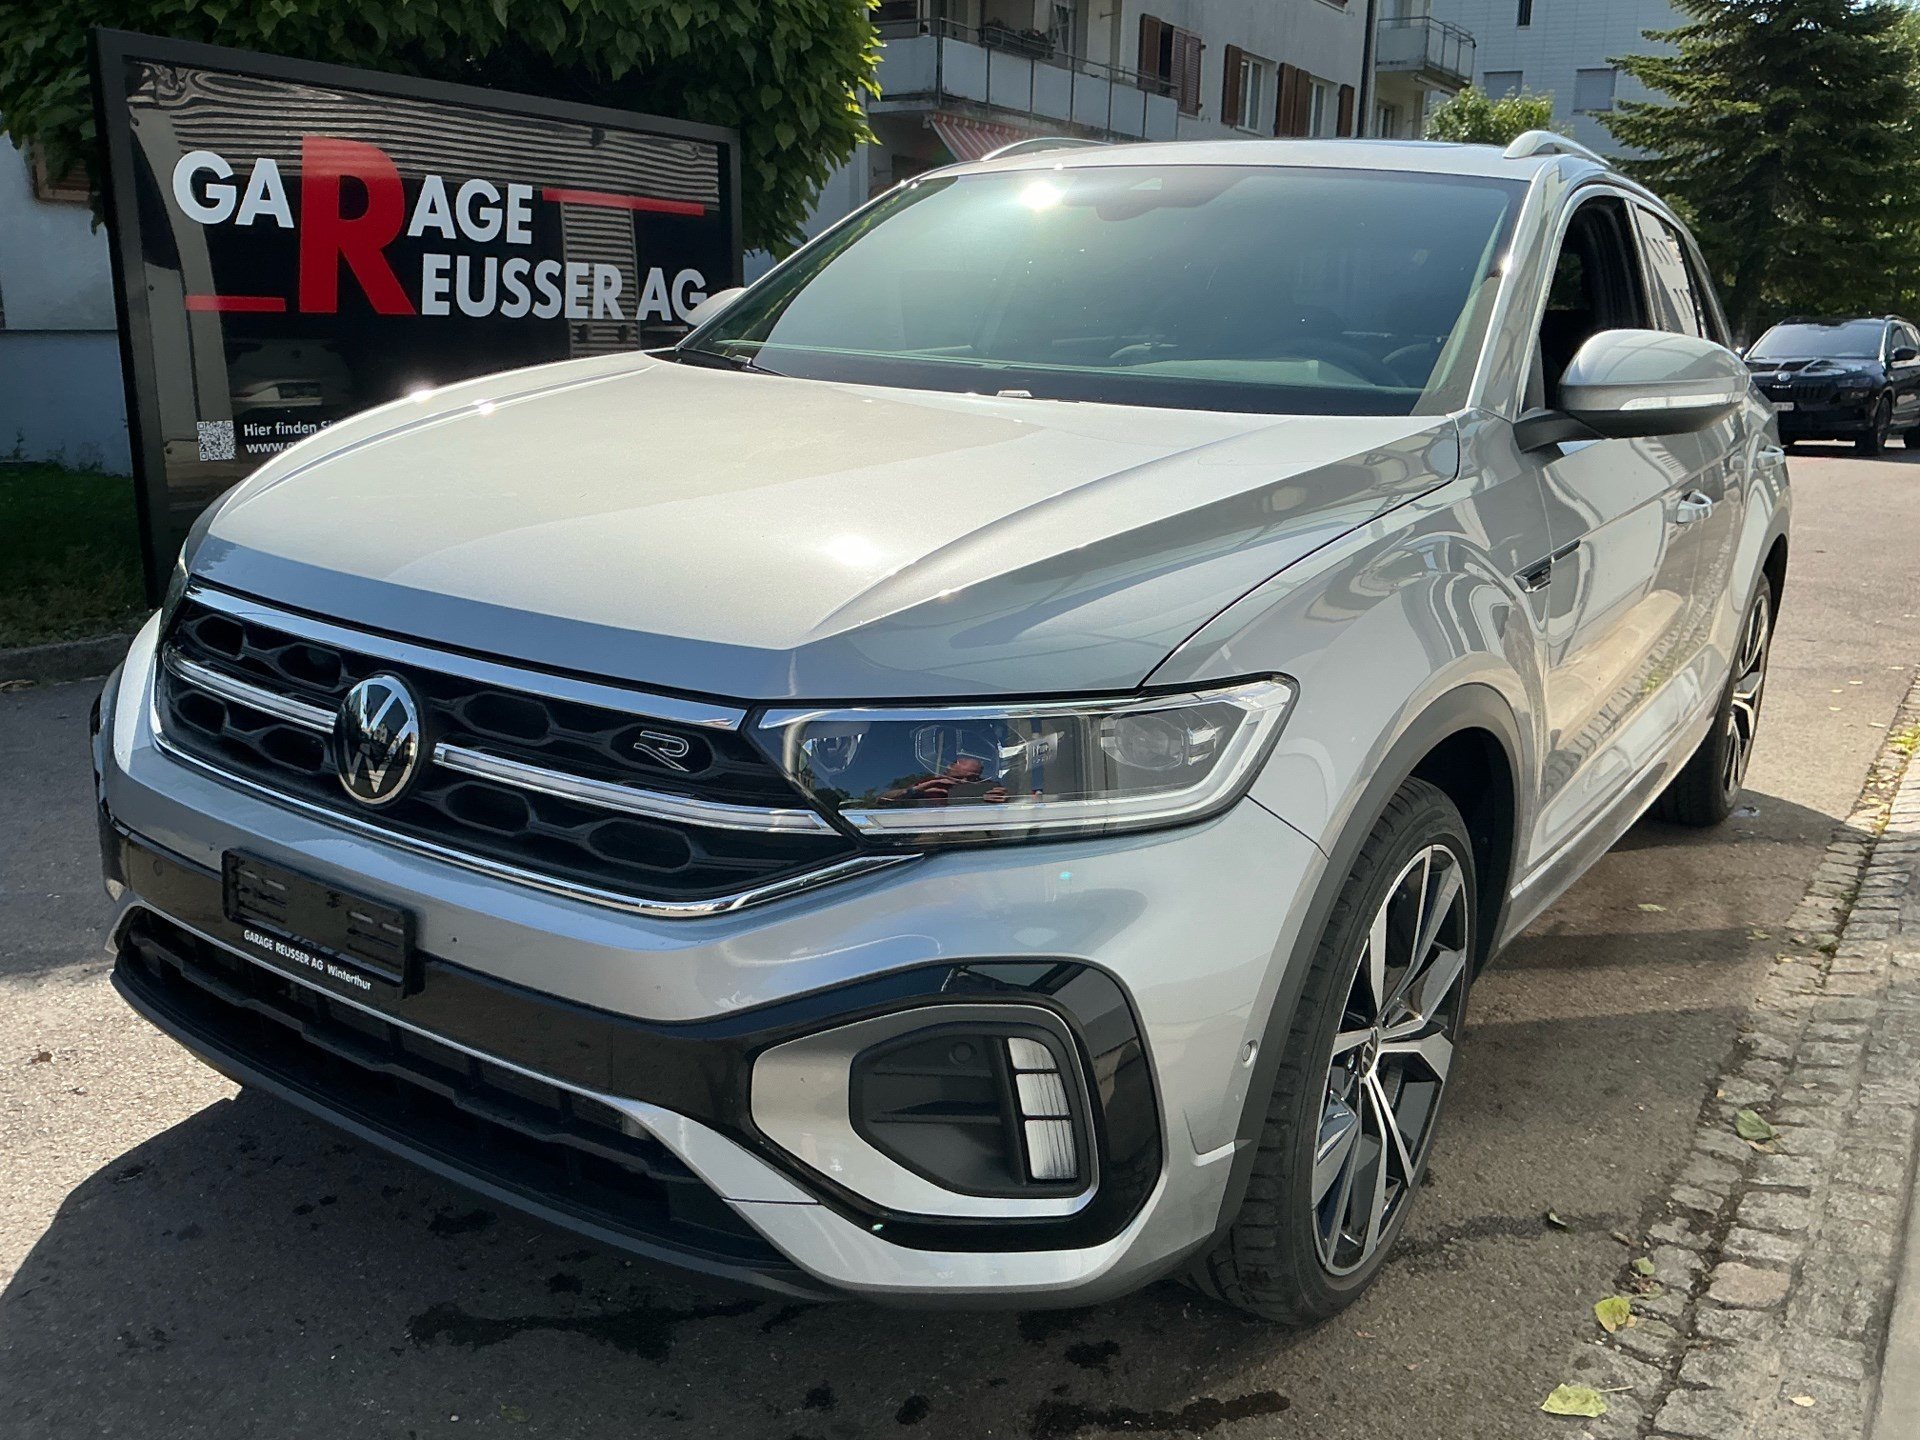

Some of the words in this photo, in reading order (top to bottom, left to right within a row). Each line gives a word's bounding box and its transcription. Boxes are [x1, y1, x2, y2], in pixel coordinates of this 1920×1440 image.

[172, 135, 533, 315] GARAGE
[635, 267, 707, 323] AG
[244, 423, 272, 436] Hier
[275, 421, 317, 434] finden
[244, 929, 273, 950] GARAGE
[275, 942, 310, 966] REUSSER
[311, 958, 324, 971] AG
[327, 964, 371, 990] Winterthur
